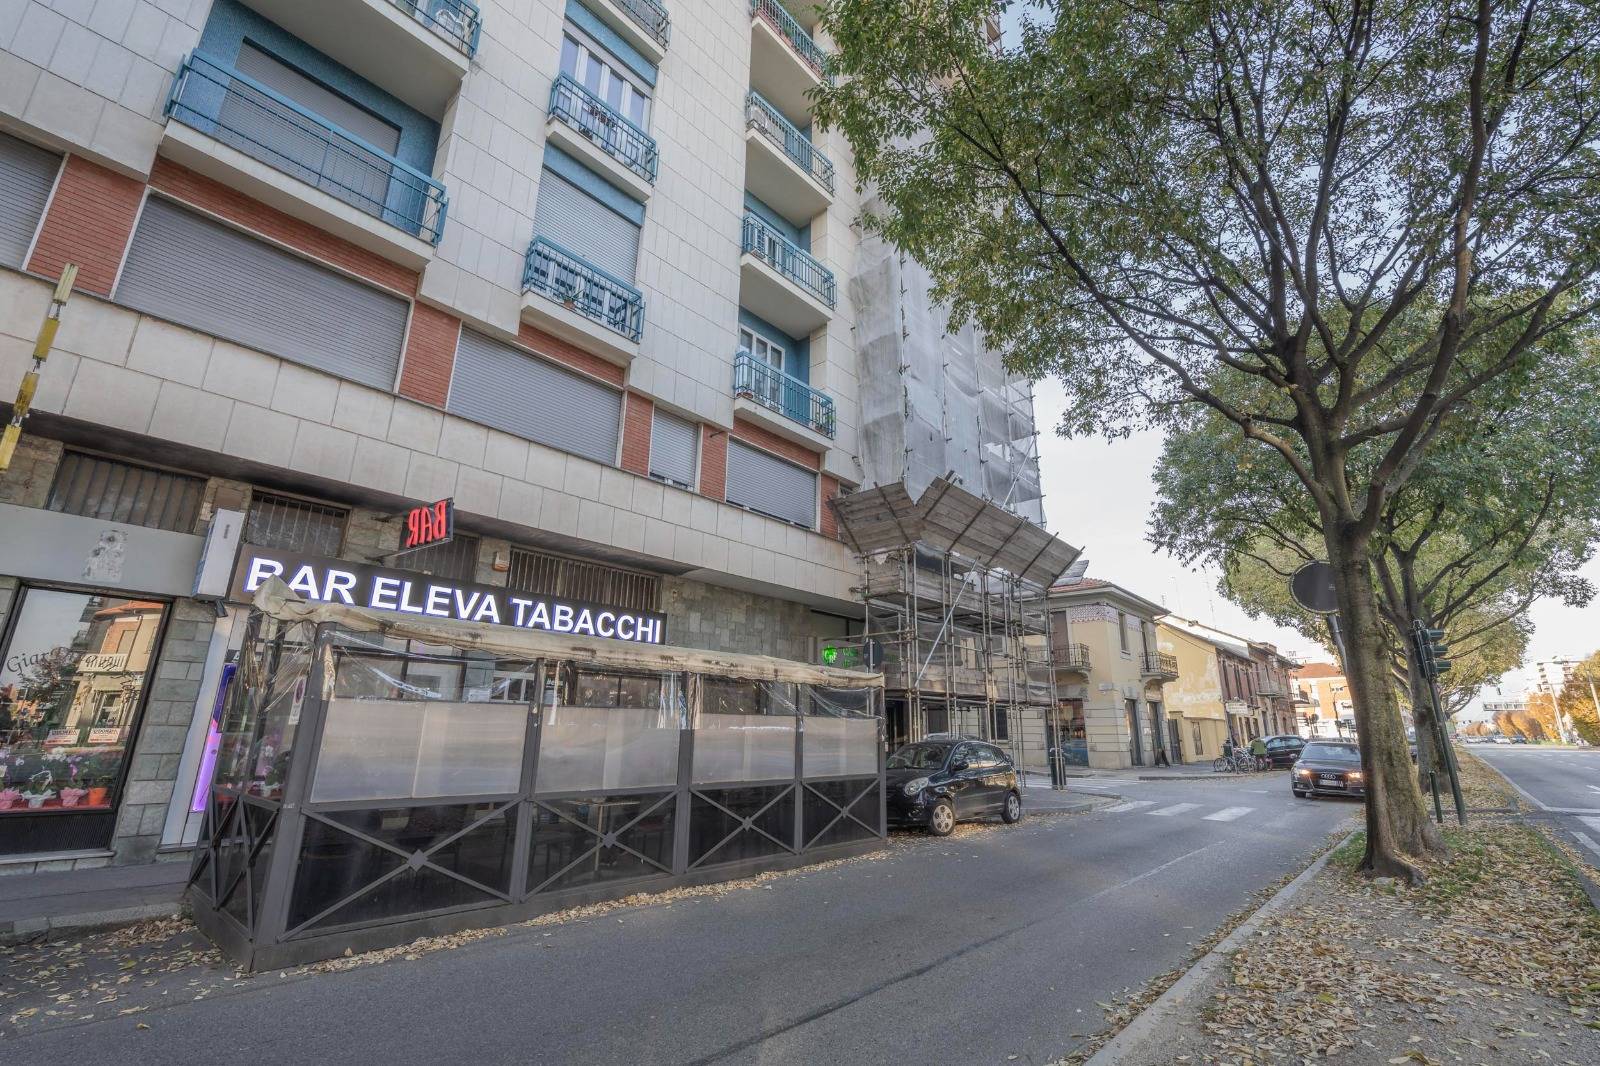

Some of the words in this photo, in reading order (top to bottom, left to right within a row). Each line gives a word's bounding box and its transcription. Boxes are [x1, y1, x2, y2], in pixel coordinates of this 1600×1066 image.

[245, 557, 357, 605] BAR
[370, 576, 501, 625] ELEVA
[510, 597, 661, 644] TABACCHI
